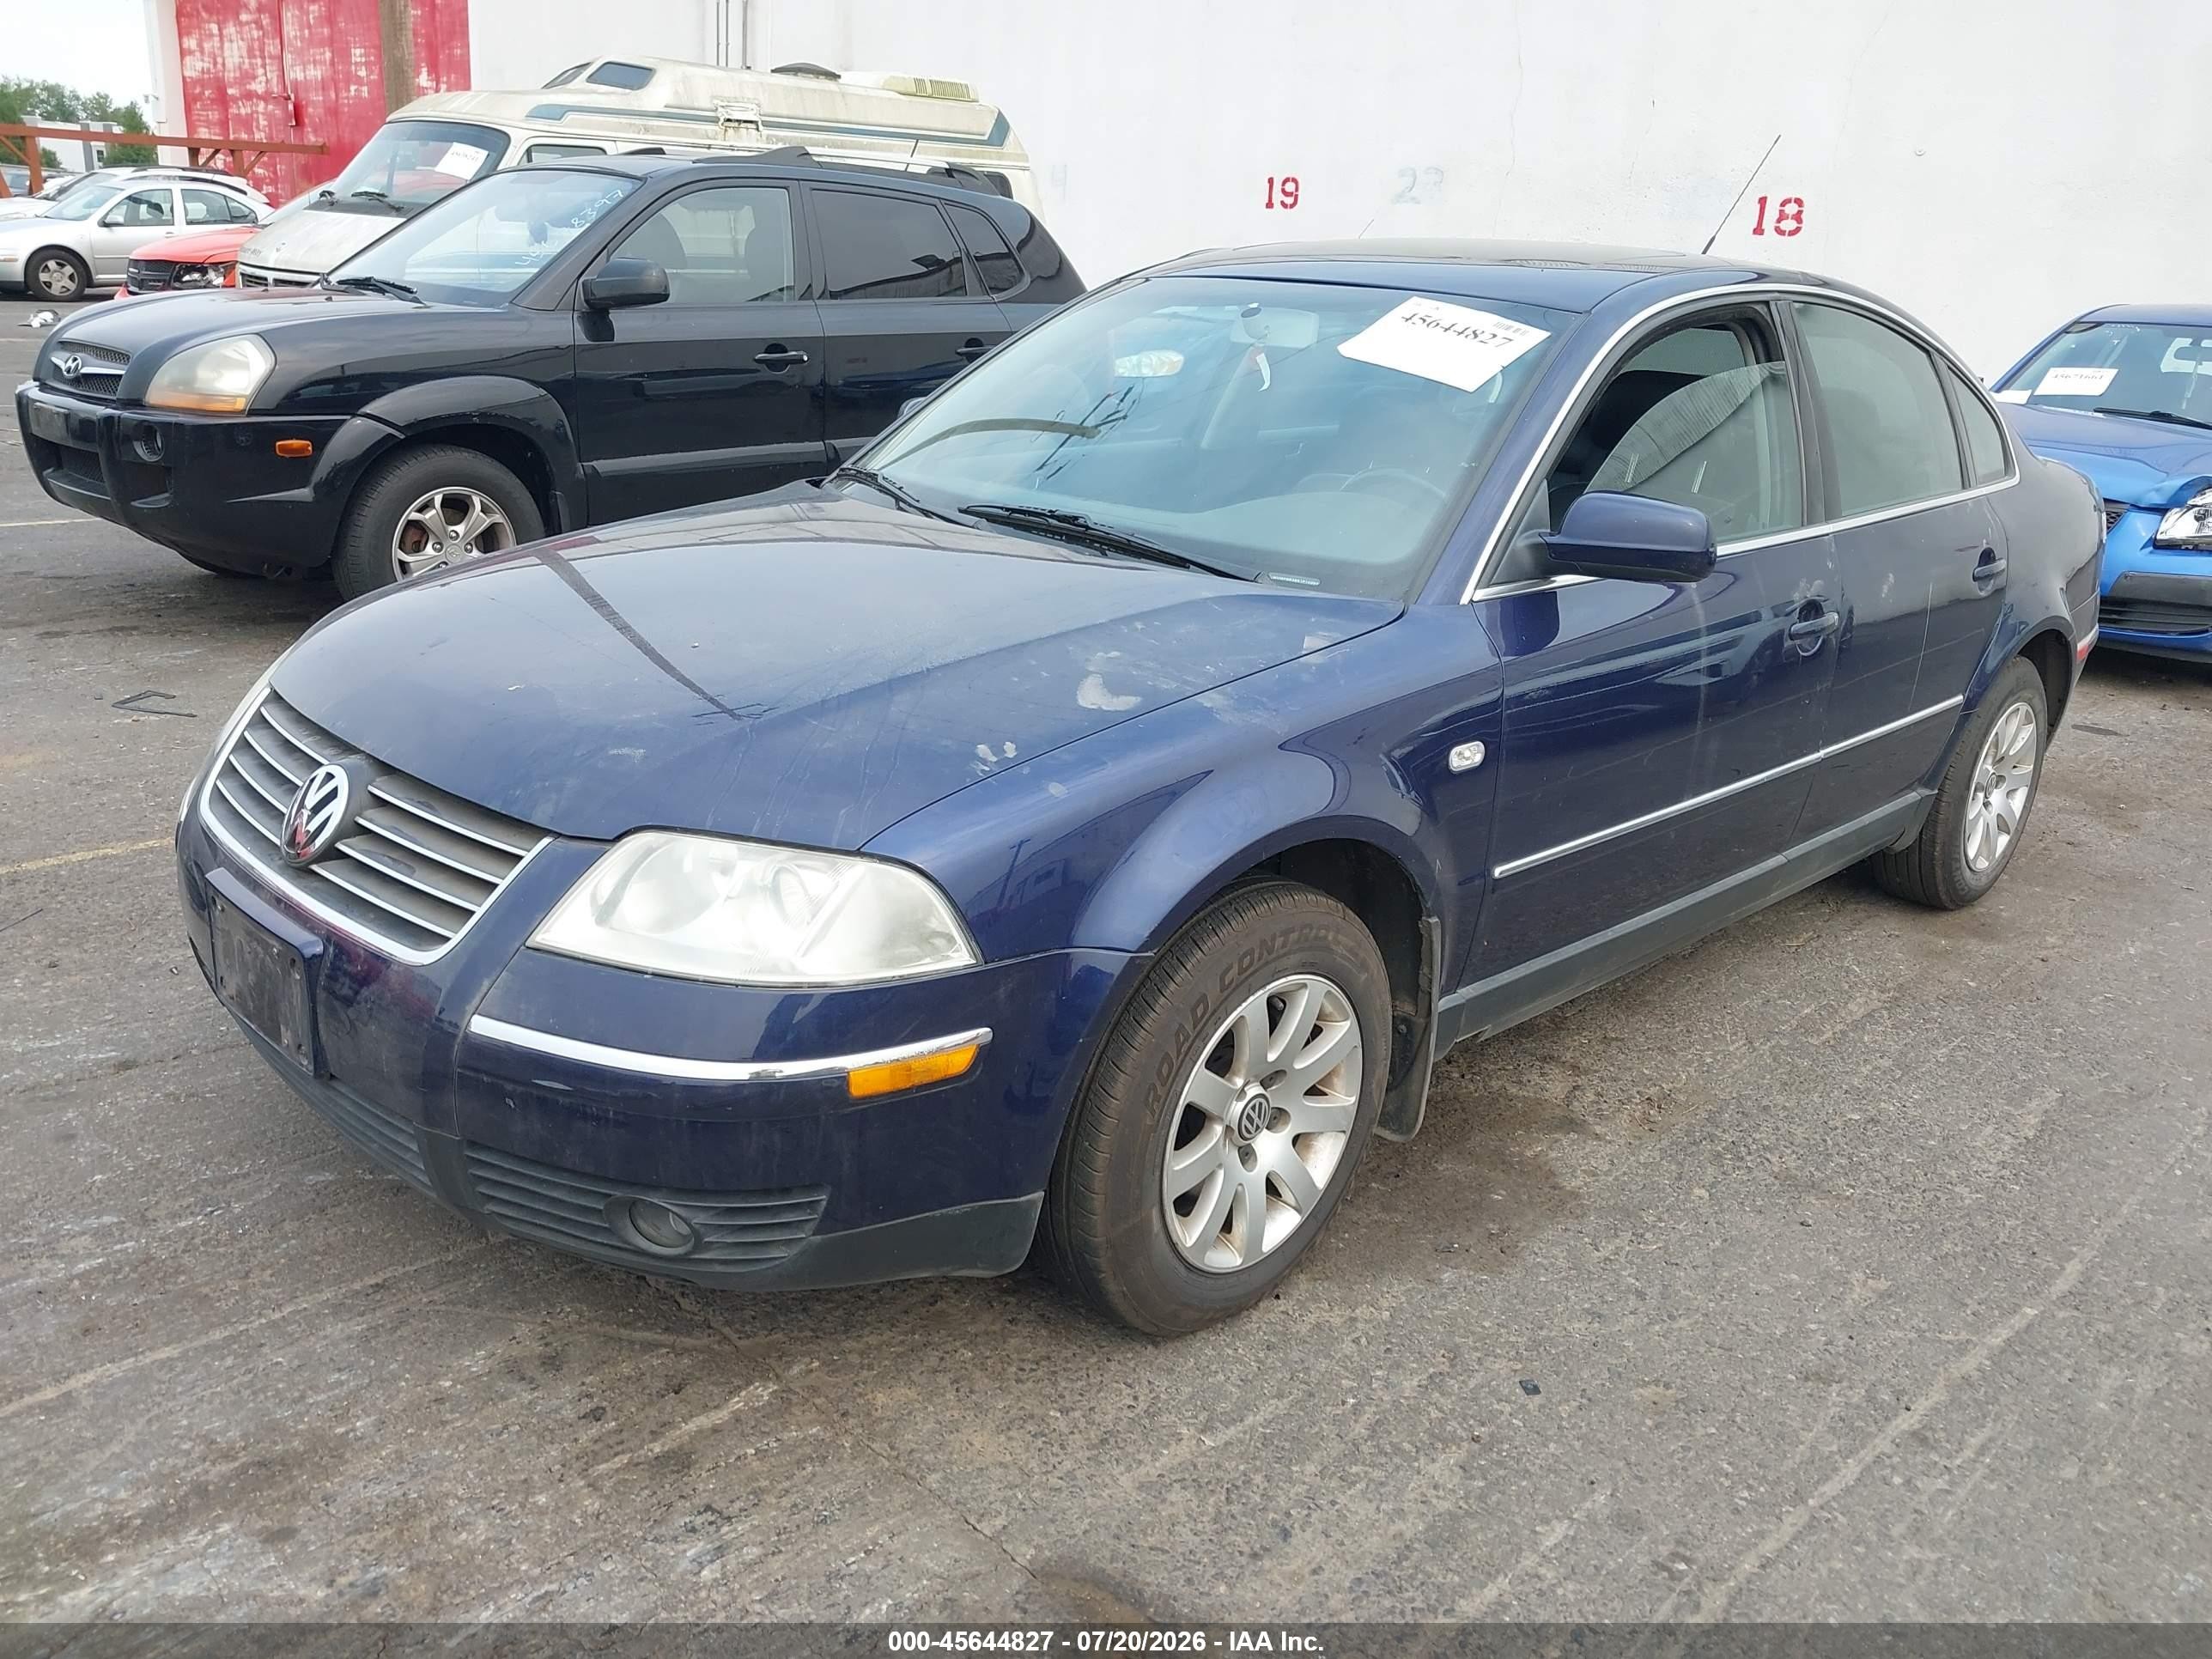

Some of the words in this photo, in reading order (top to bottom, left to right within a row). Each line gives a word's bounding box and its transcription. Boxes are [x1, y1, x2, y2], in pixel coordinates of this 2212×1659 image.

[1265, 176, 1300, 210] 19
[1752, 196, 1805, 237] 18
[1401, 312, 1515, 348] 45644827
[1145, 992, 1211, 1119] ROAD
